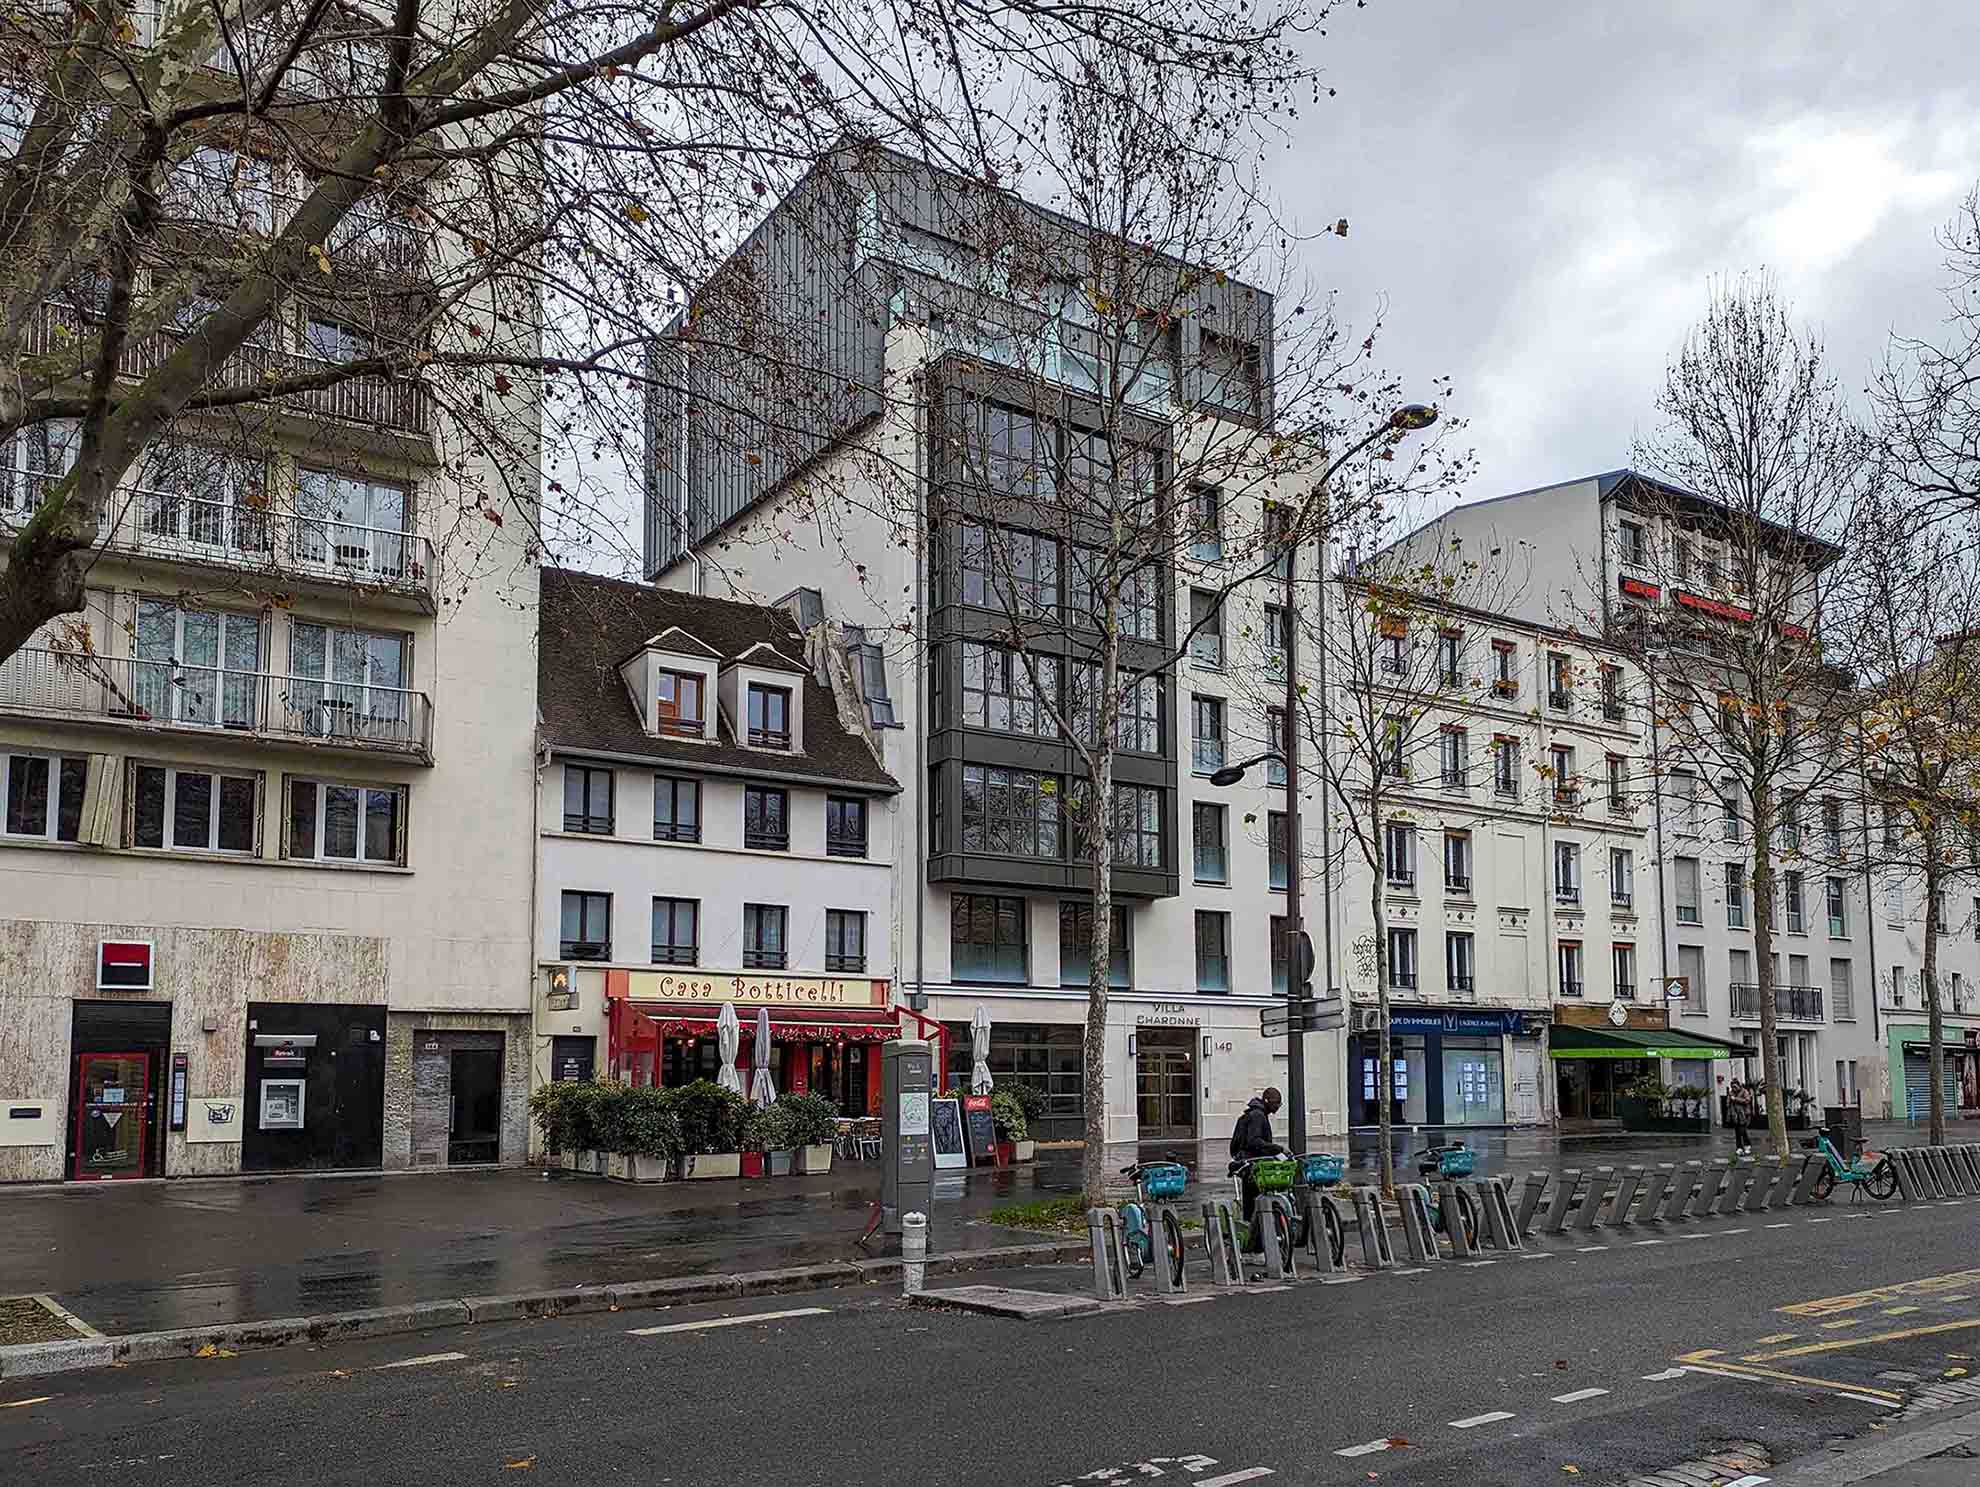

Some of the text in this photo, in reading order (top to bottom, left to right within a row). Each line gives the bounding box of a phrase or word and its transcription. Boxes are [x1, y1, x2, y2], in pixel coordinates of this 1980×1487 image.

[660, 975, 844, 1001] Casa Botticelli
[1153, 1001, 1185, 1013] VILLA
[1136, 1015, 1201, 1025] CHARONNE
[1215, 1040, 1233, 1050] 140
